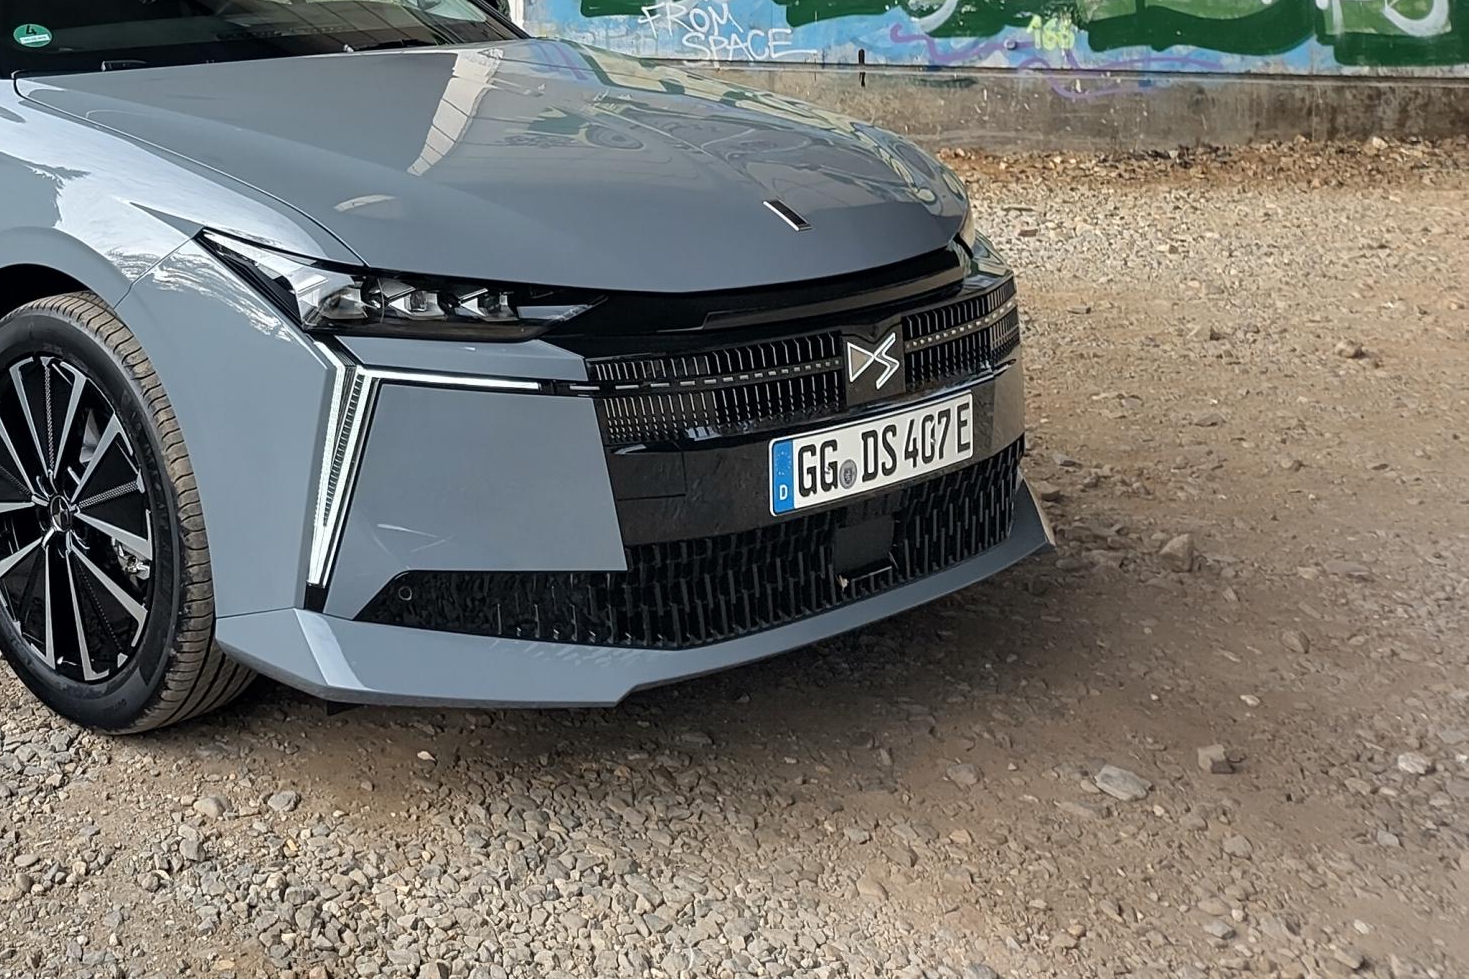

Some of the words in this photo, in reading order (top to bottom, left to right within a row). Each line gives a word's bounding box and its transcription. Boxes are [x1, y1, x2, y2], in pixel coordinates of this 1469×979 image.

[637, 0, 744, 38] FROM
[682, 27, 818, 70] SPACE
[778, 483, 789, 501] D
[797, 439, 839, 497] GG
[861, 424, 898, 482] DS
